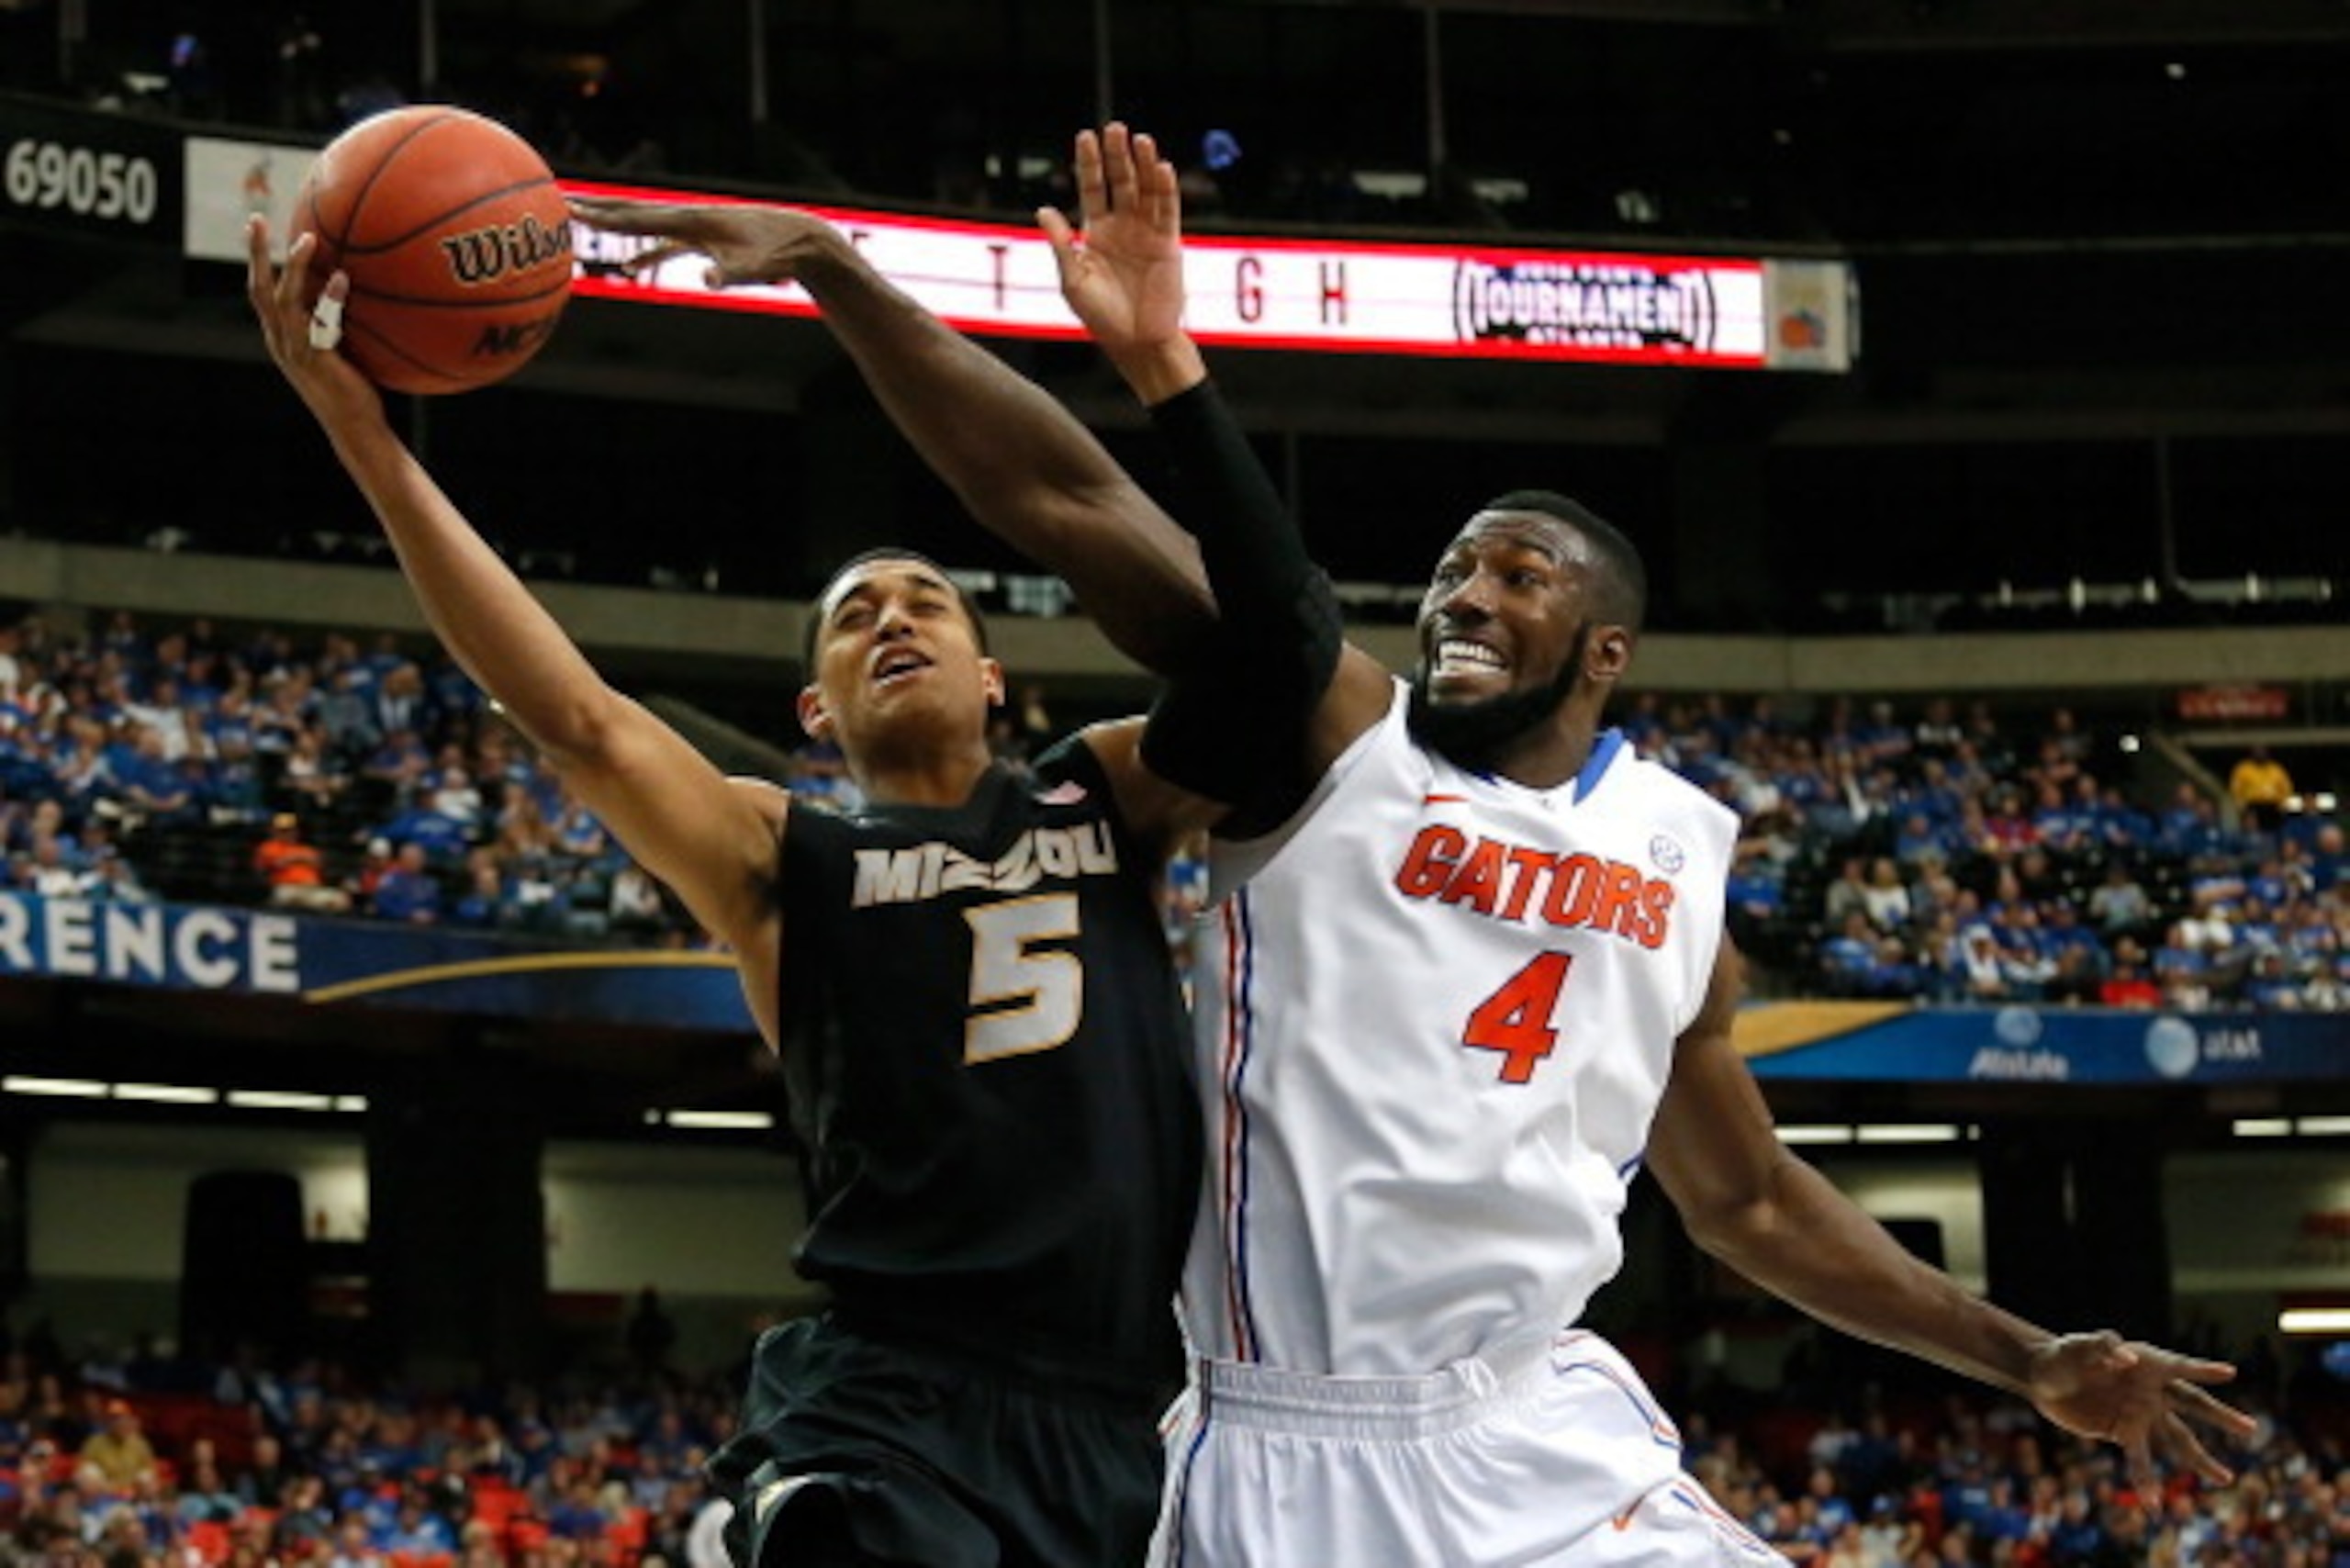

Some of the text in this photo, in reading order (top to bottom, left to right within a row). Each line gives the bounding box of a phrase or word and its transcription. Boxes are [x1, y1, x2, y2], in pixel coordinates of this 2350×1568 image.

[6, 140, 158, 223] 69050
[1471, 261, 1698, 342] TOURNAMENT
[0, 892, 301, 993] RENCE
[1393, 823, 1675, 950] GATORS
[964, 890, 1085, 1067] 5
[1462, 949, 1572, 1085] 4
